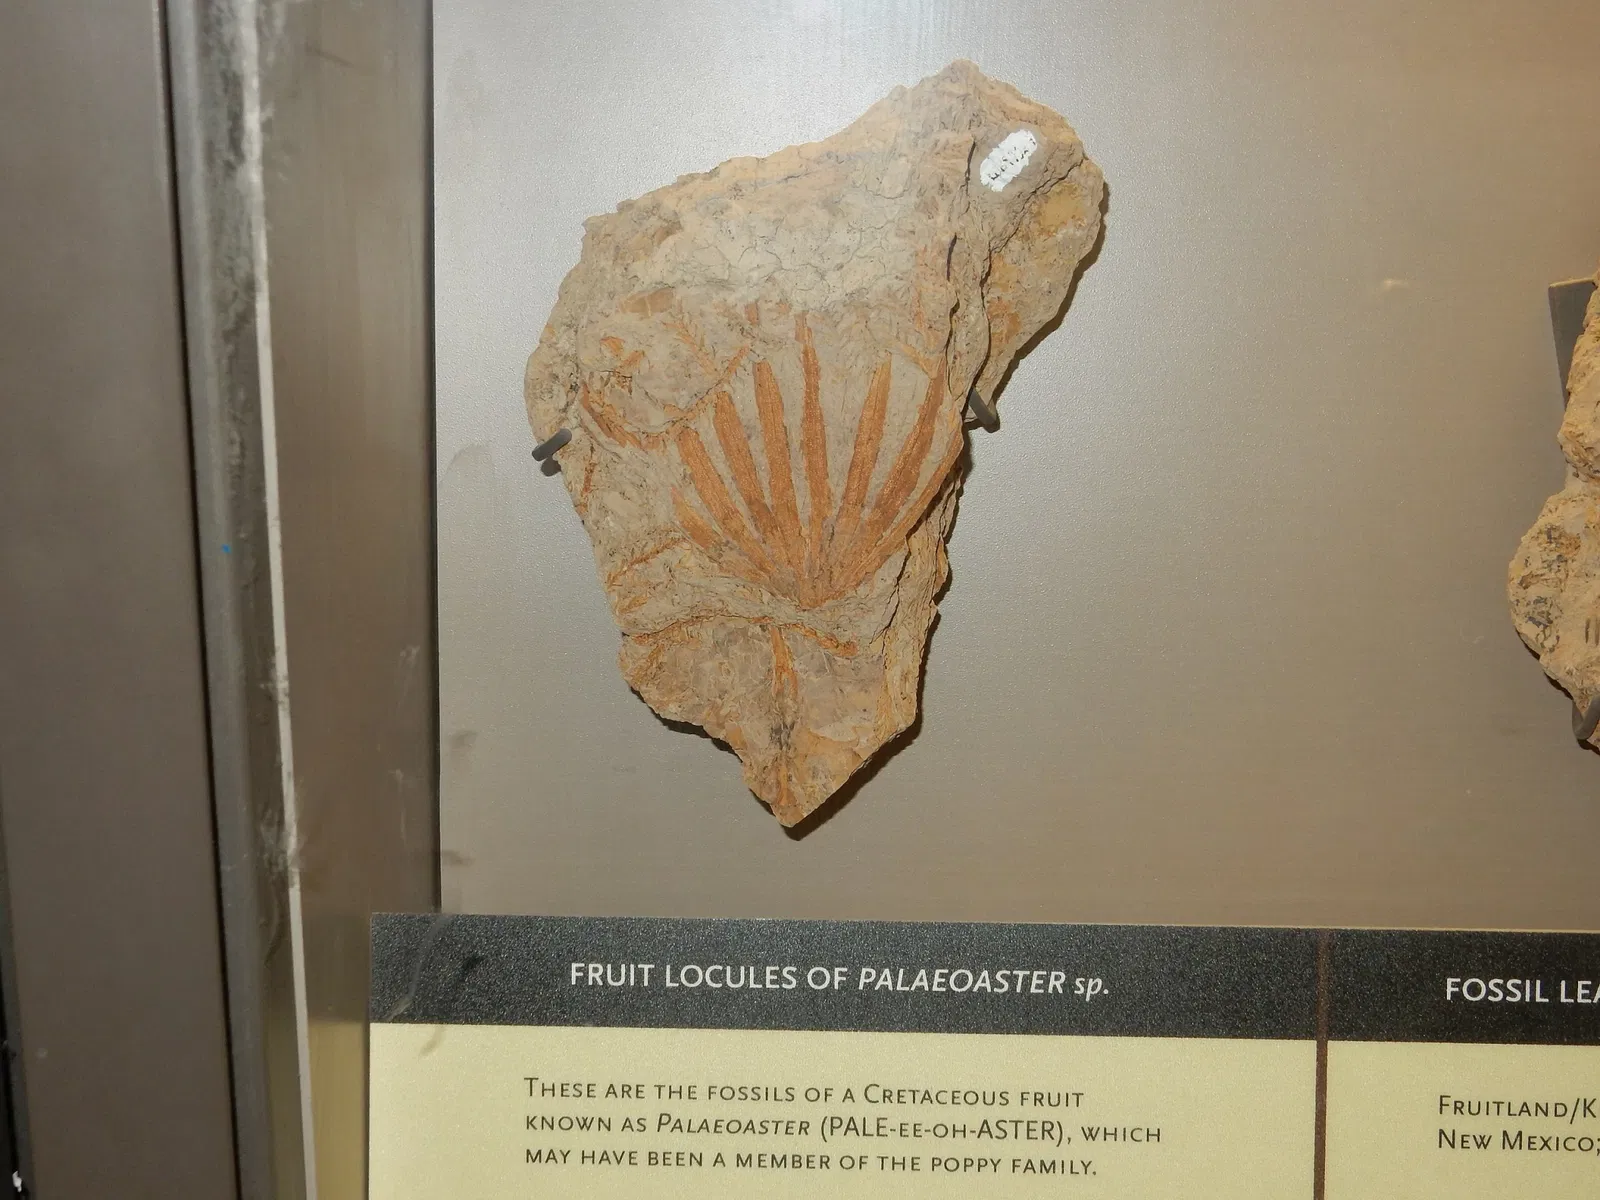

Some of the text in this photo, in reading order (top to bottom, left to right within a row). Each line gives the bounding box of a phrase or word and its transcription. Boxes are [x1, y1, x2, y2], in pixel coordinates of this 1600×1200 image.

[571, 962, 1109, 1002] FRUIT LOCULES OF PALAEOASTER sp.
[1446, 978, 1549, 1002] FOSSIL
[524, 1077, 1084, 1108] THESE ARE THE FOSSILS OF A CRETACEOUS FRUIT
[526, 1113, 1161, 1148] KNOWN AS PALAEOASTER (PALE-EE-OH-ASTER), WHICH
[1438, 1128, 1493, 1150] NEW
[525, 1148, 1097, 1175] MAY HAVE BEEN A MEMBER OF THE POPPY FAMILY.
